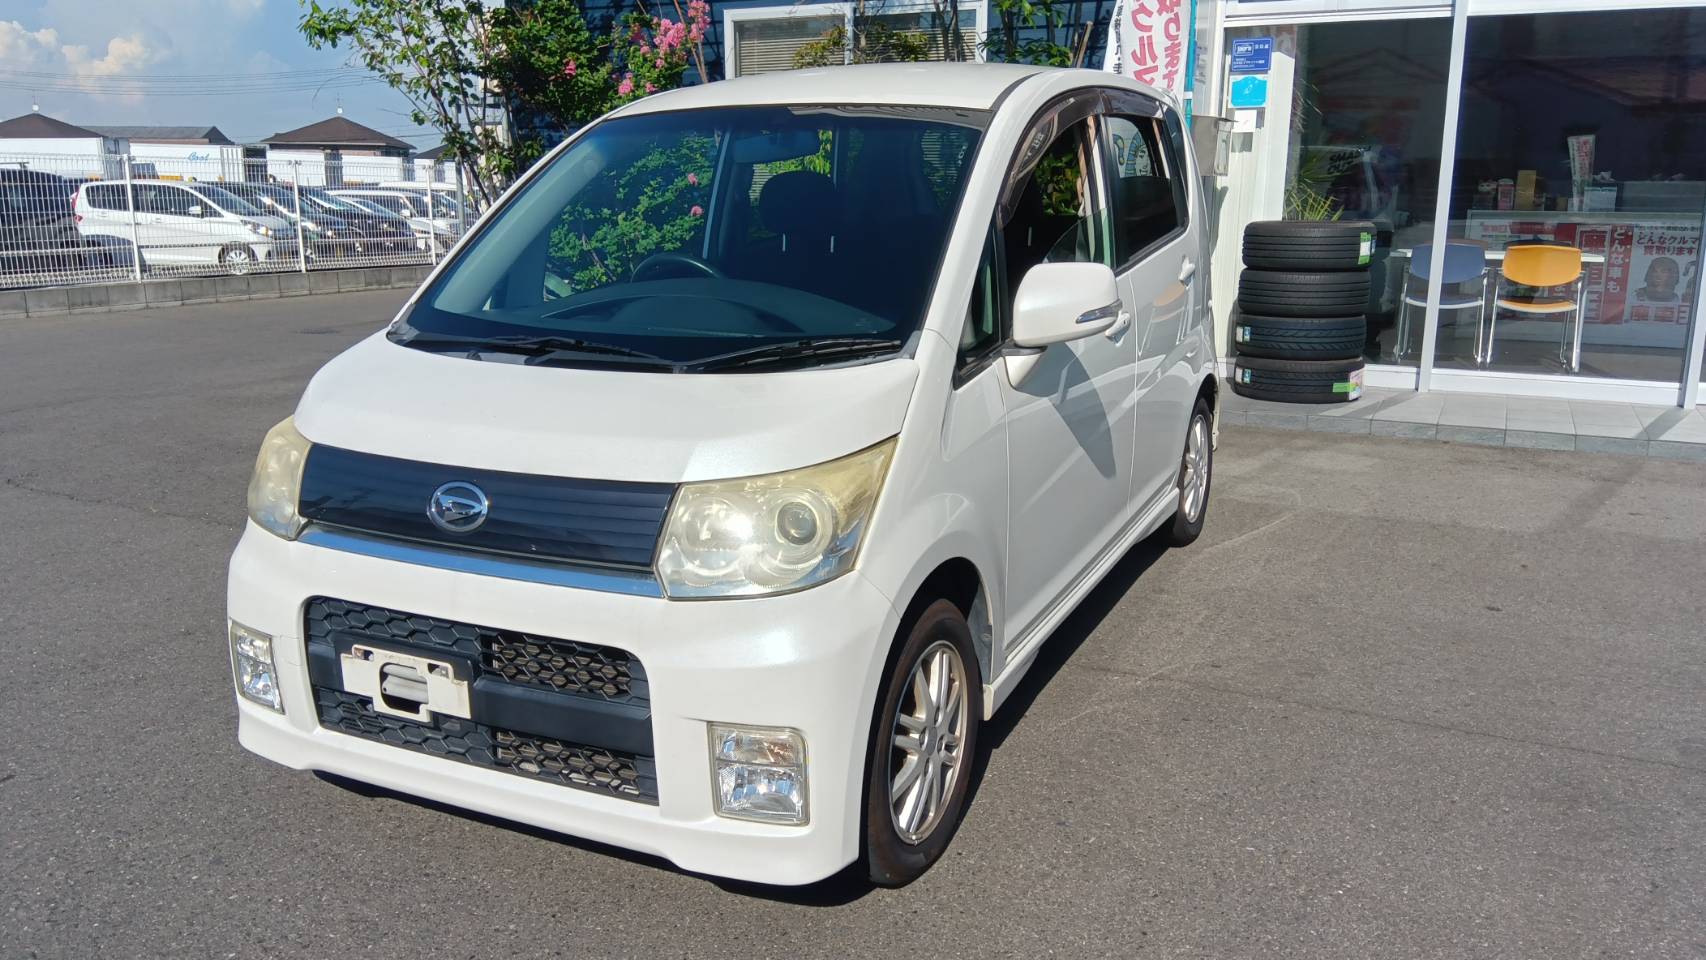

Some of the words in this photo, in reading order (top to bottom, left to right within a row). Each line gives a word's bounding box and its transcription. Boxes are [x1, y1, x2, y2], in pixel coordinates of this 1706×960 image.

[1636, 234, 1699, 245] どんなクルマ
[1606, 226, 1627, 293] どんな車も
